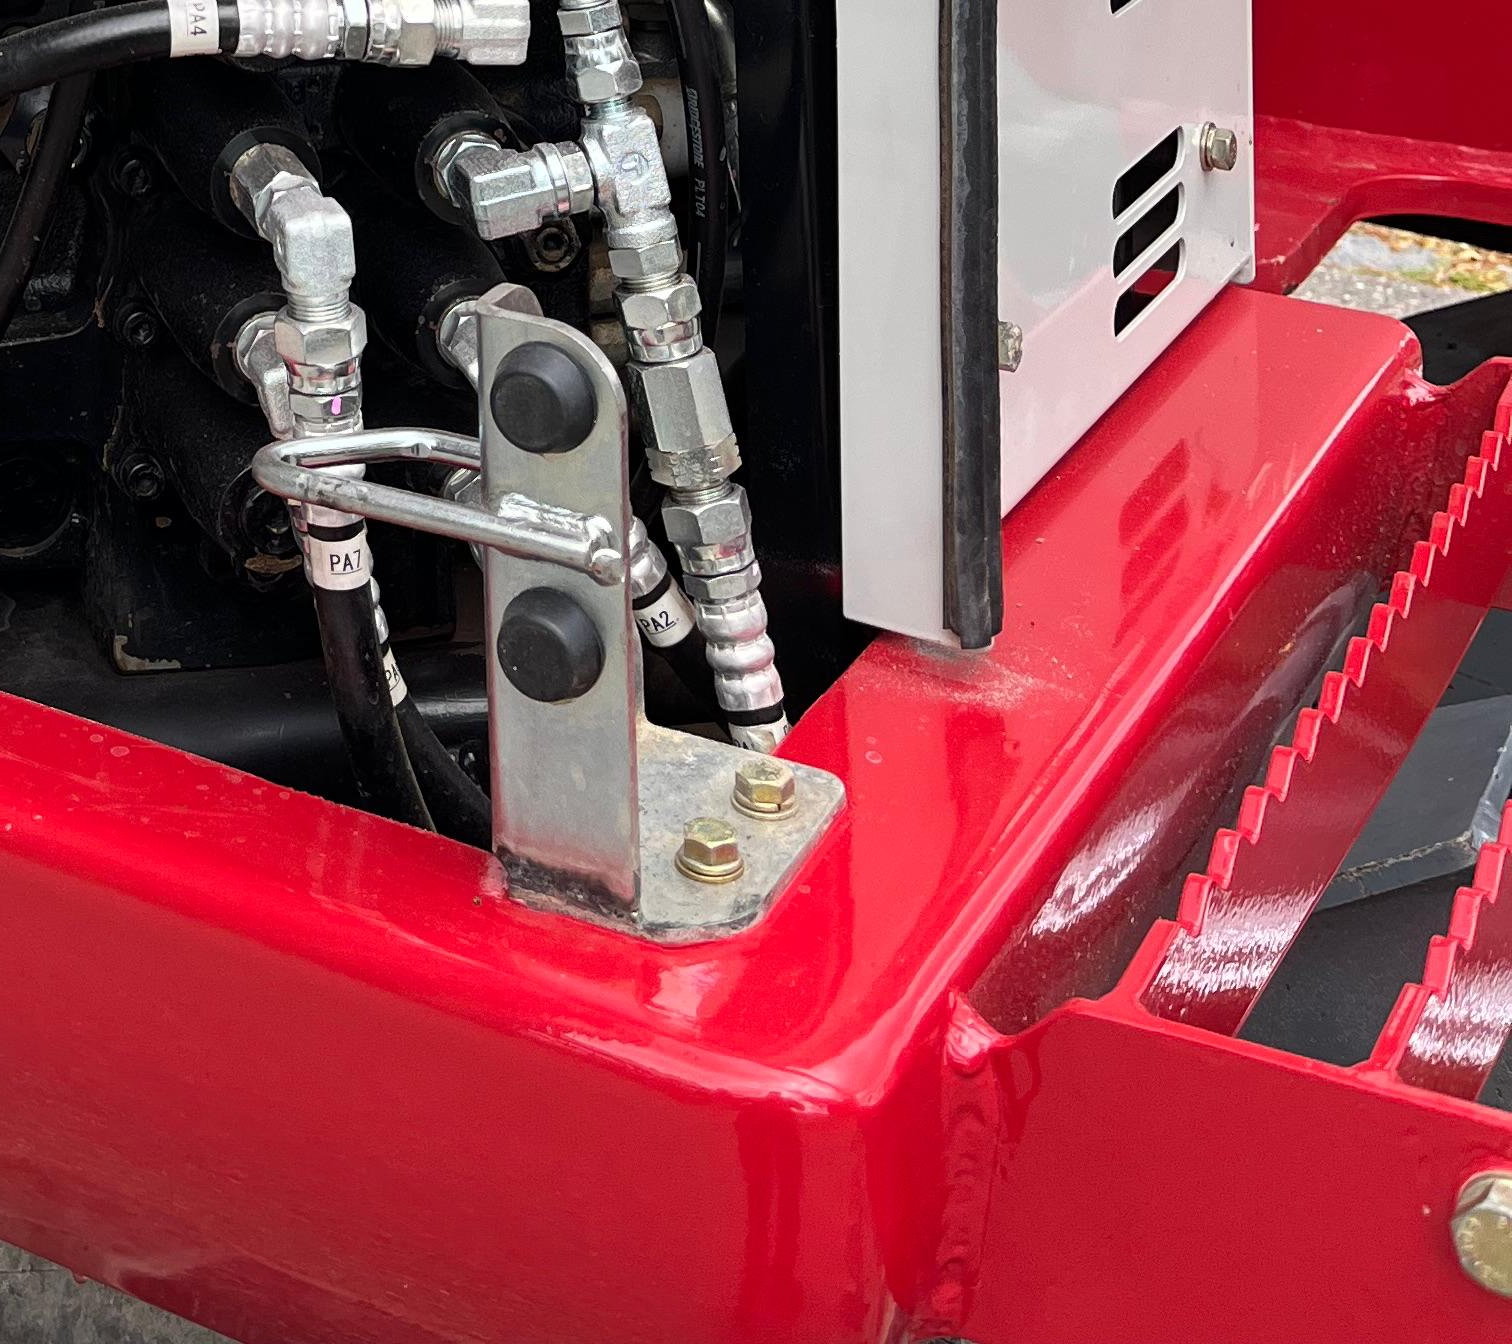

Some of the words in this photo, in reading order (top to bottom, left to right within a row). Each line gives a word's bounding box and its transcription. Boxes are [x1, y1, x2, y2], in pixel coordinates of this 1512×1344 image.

[187, 1, 208, 37] PA4
[329, 548, 362, 573] PA7
[639, 610, 674, 632] PA2
